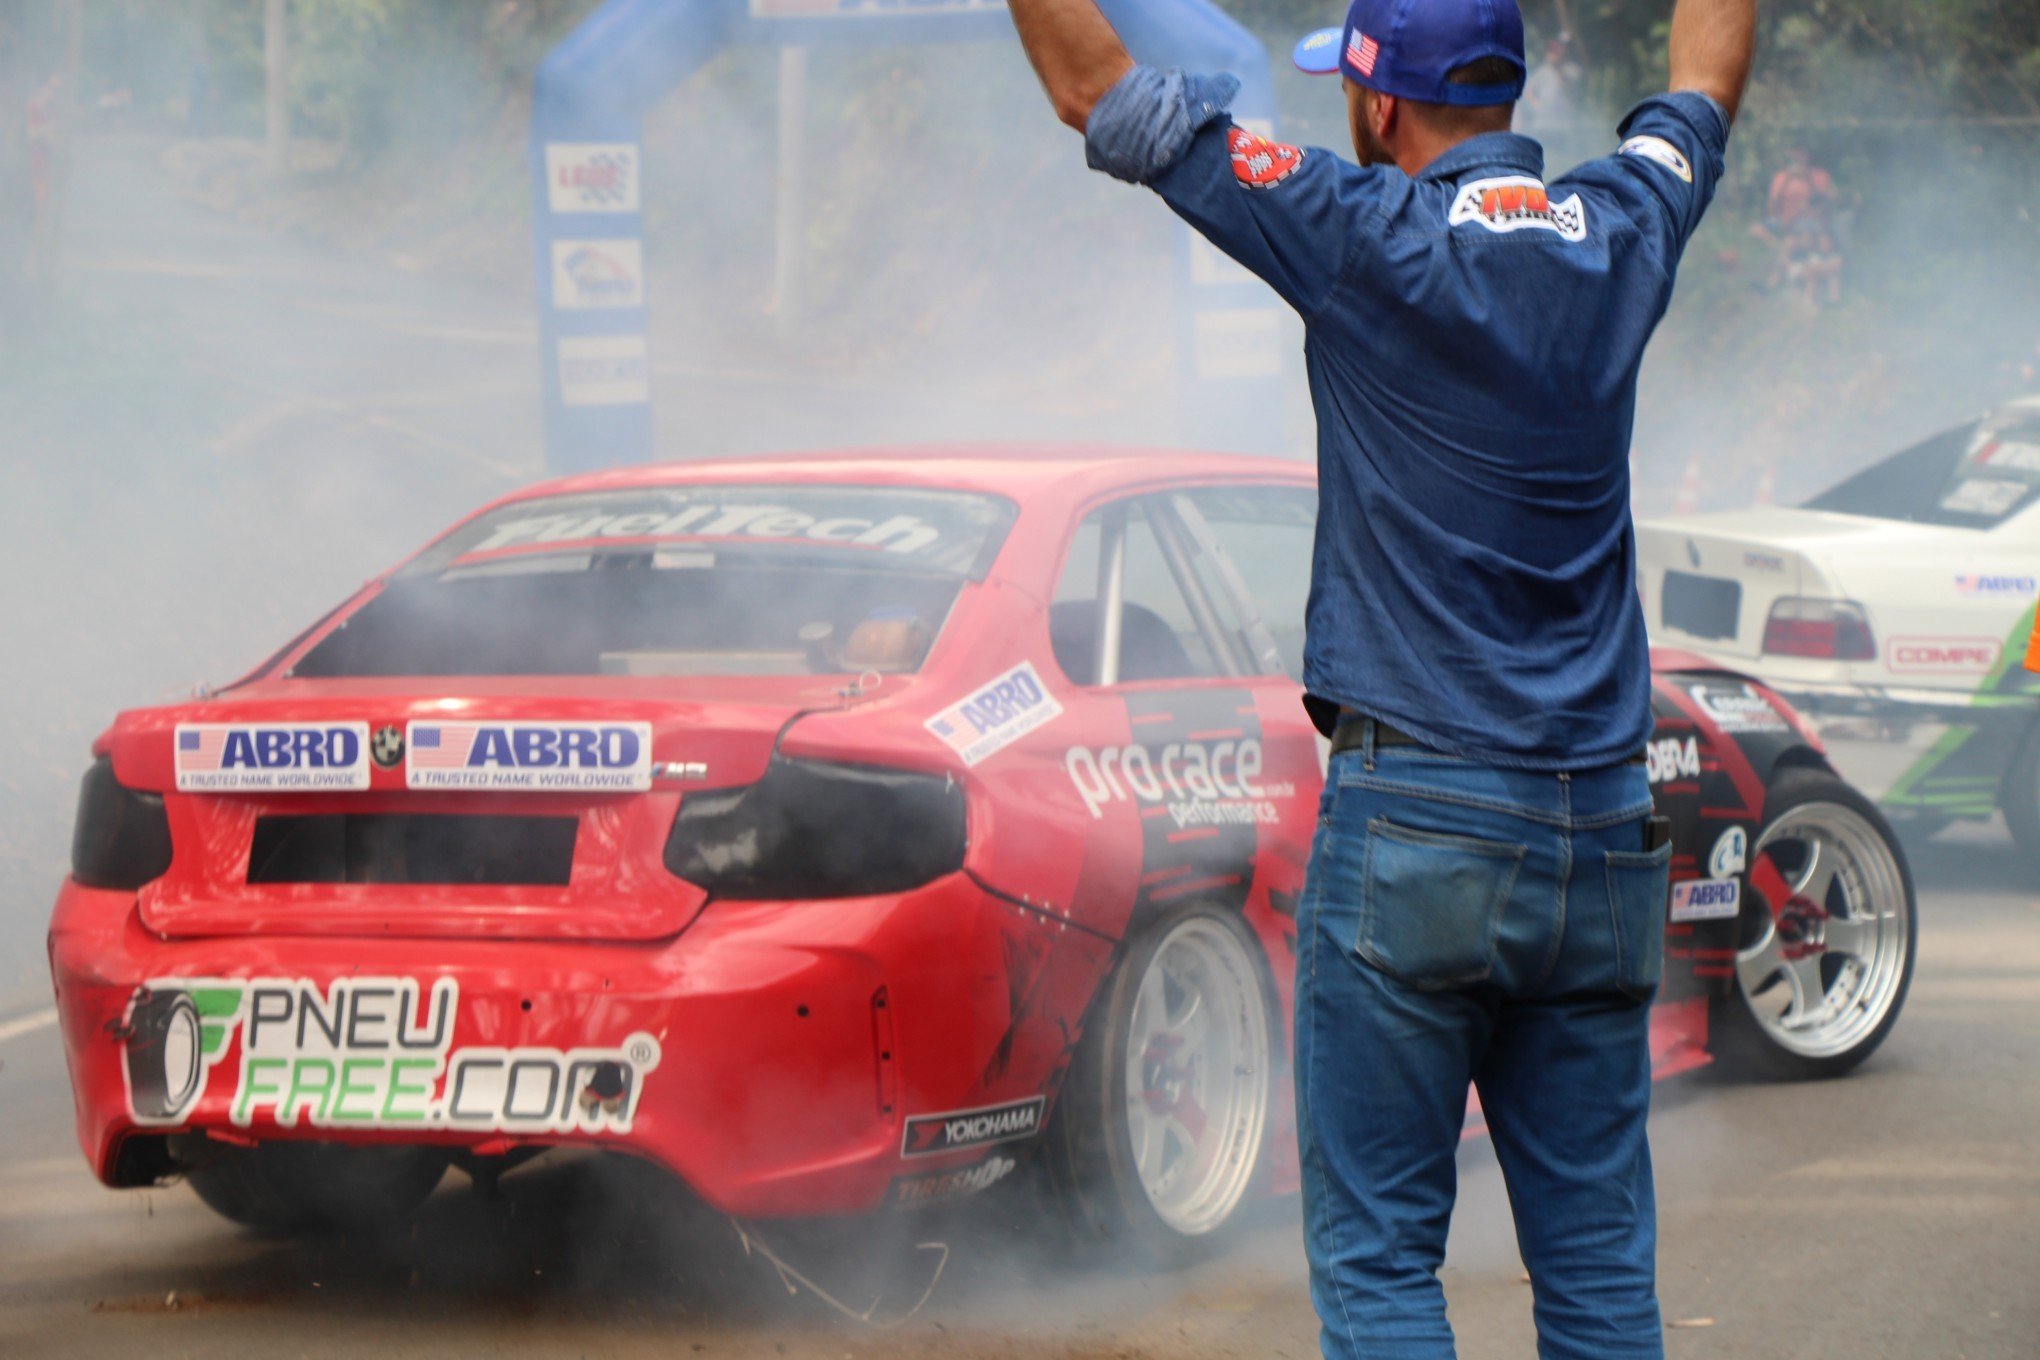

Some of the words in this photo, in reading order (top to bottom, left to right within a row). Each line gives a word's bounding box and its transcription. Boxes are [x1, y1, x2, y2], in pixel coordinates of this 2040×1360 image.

[472, 504, 938, 553] FuelTech
[960, 670, 1043, 735] ABRO
[221, 728, 359, 769] ABRO
[467, 727, 640, 769] ABRO
[180, 774, 187, 786] A
[190, 773, 239, 787] TRUSTED
[241, 773, 273, 787] NAME
[278, 772, 356, 786] WORLDWIDE
[411, 772, 421, 785] A
[426, 772, 489, 786] TRUSTED
[492, 772, 534, 787] NAME
[539, 773, 635, 787] WORLDWIDE
[1168, 795, 1280, 829] performance
[1689, 881, 1736, 907] ABRO
[248, 988, 451, 1050] PNEU
[945, 1107, 1035, 1144] YOKOHAMA
